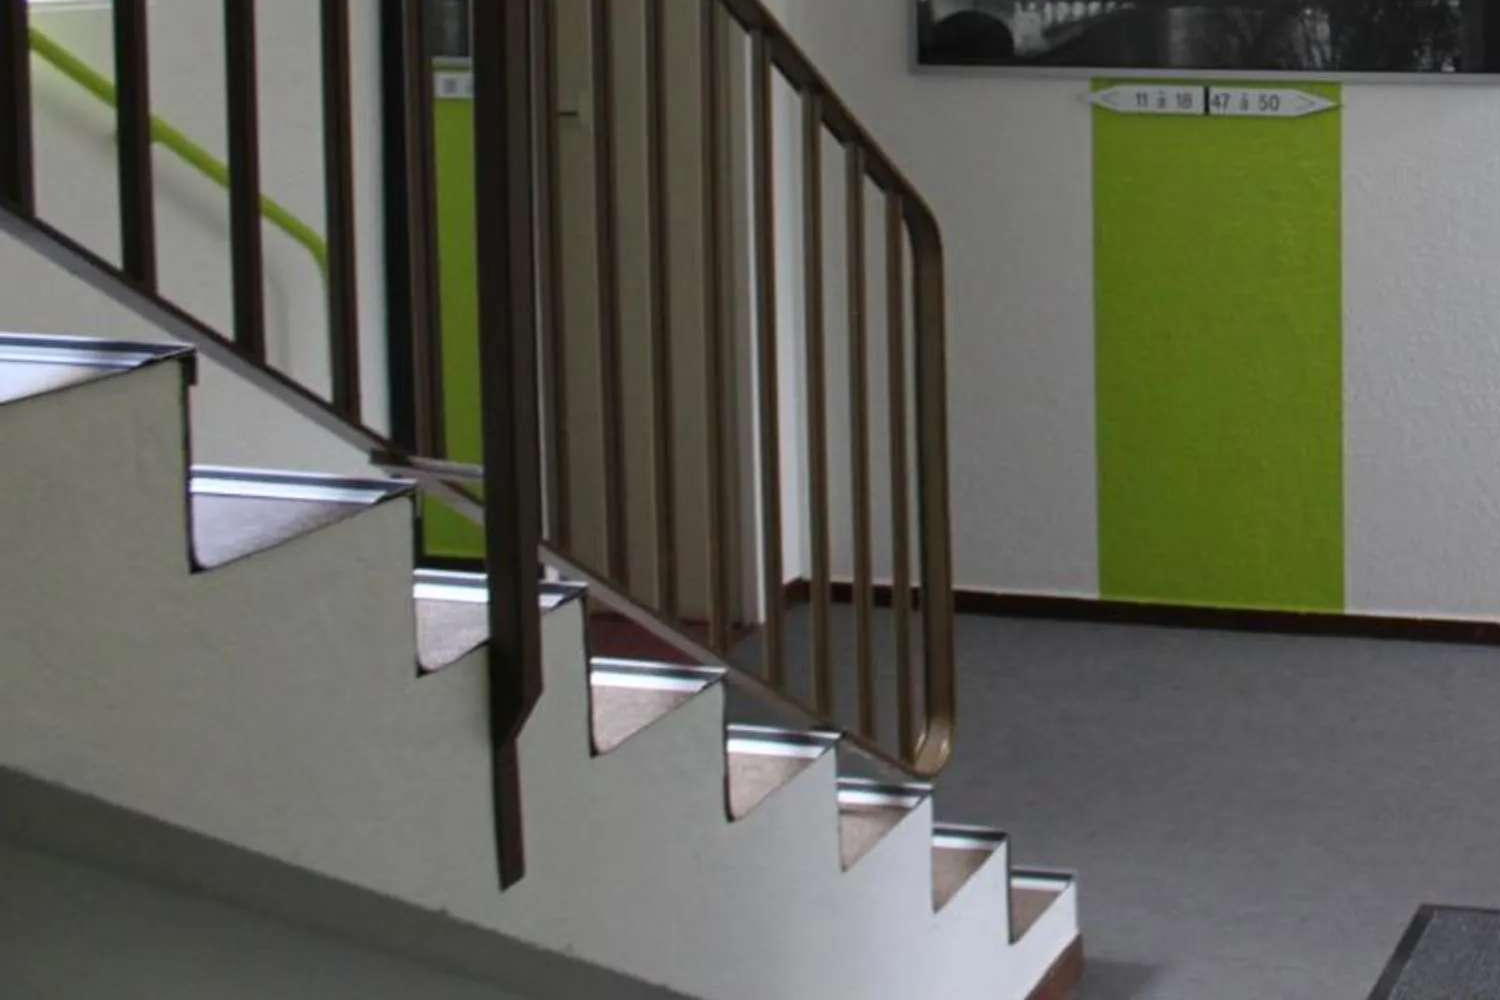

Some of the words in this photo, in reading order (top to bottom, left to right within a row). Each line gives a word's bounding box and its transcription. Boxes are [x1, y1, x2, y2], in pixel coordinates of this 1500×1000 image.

[1135, 91, 1149, 108] 11
[1211, 92, 1232, 111] 47
[1258, 93, 1280, 112] 50
